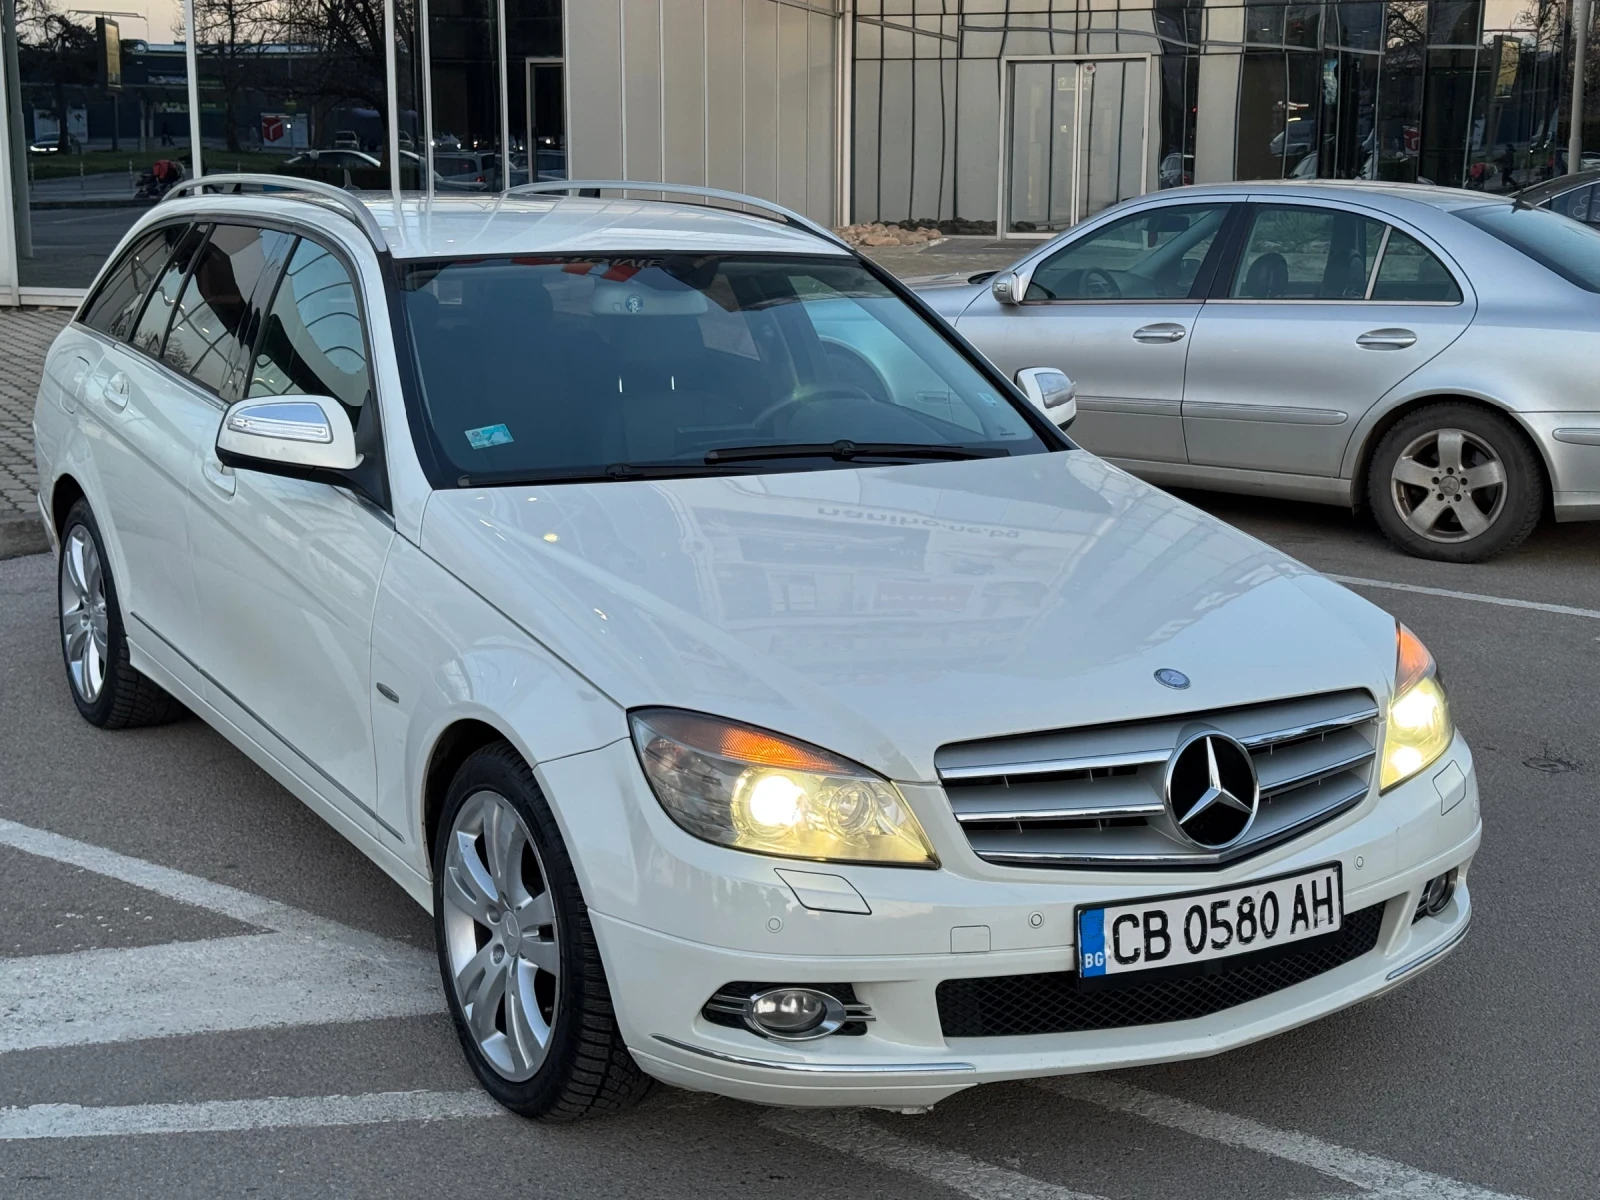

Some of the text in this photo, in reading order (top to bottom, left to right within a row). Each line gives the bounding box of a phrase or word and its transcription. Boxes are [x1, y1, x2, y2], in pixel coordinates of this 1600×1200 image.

[1112, 876, 1334, 965] CB 0580 AH
[1084, 952, 1104, 968] BG
